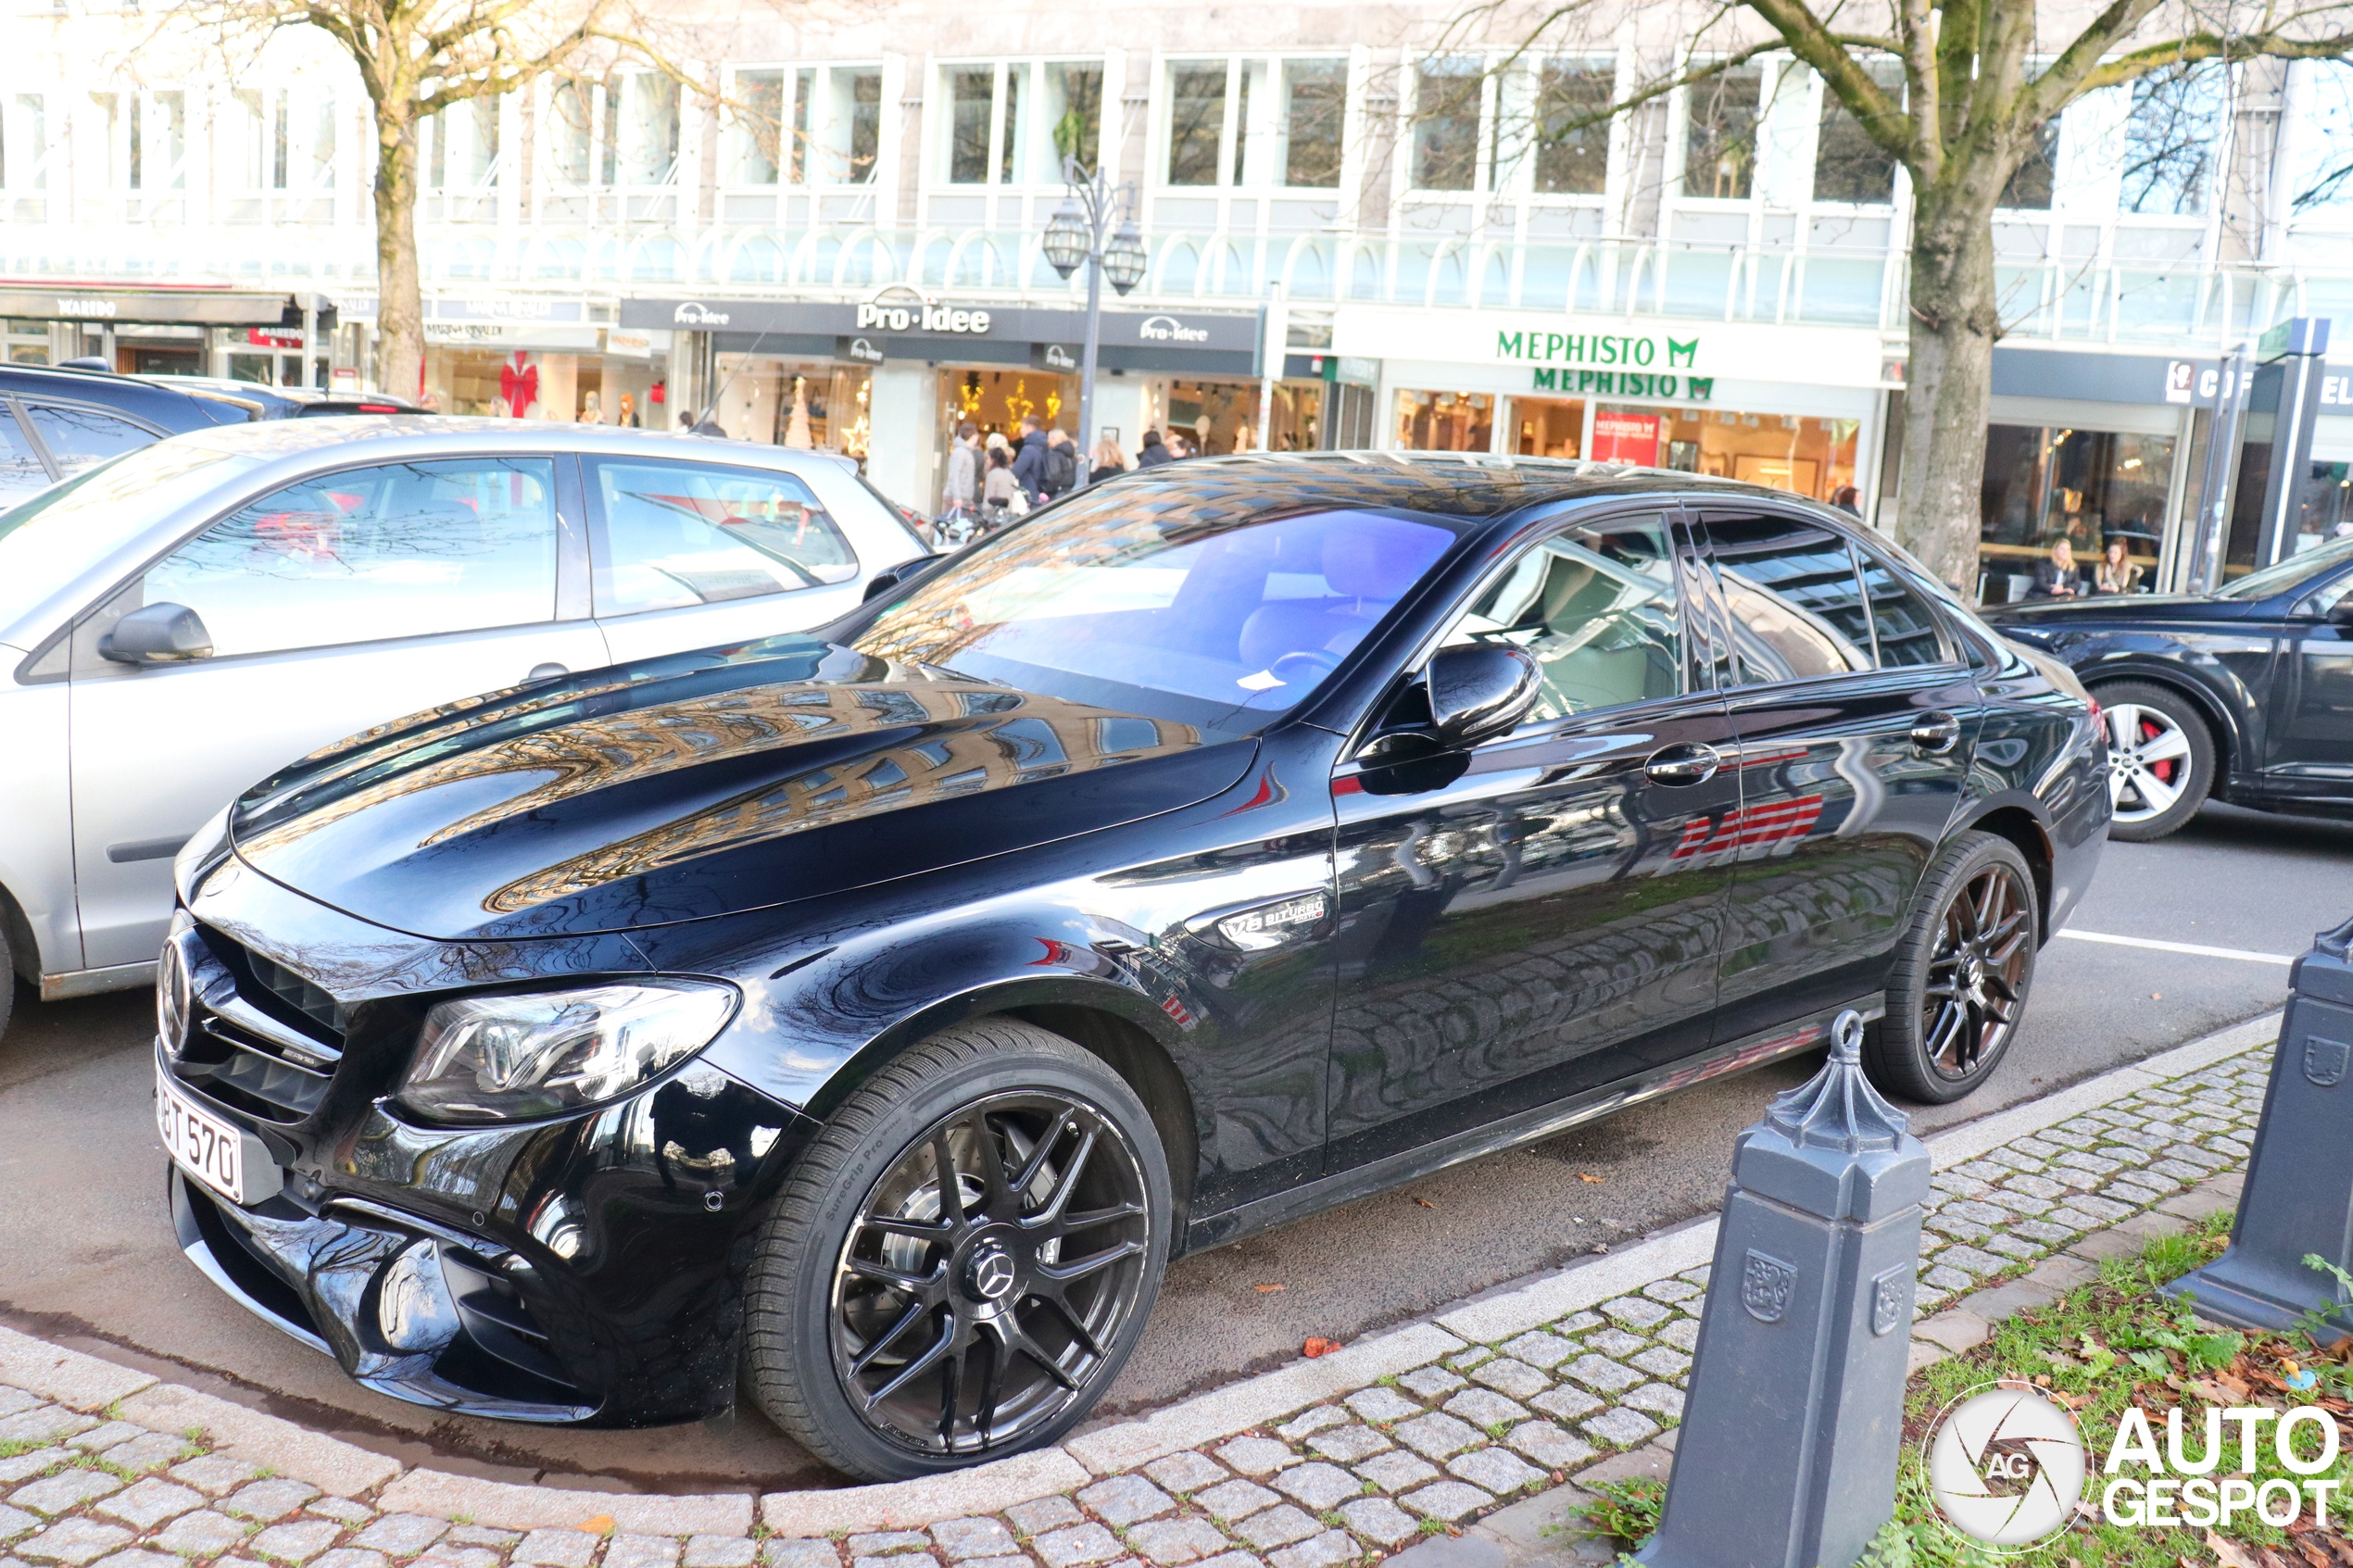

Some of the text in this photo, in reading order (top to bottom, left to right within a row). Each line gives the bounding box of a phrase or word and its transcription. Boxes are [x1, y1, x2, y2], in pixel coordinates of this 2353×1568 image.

[57, 298, 117, 317] MAREDO
[1496, 331, 1655, 367] MEPHISTO
[1533, 368, 1678, 397] MEPHISTO
[1226, 900, 1324, 937] V8 BITURBO
[187, 1112, 235, 1188] 570
[825, 1162, 864, 1222] SureGrip
[862, 1139, 883, 1161] Pro
